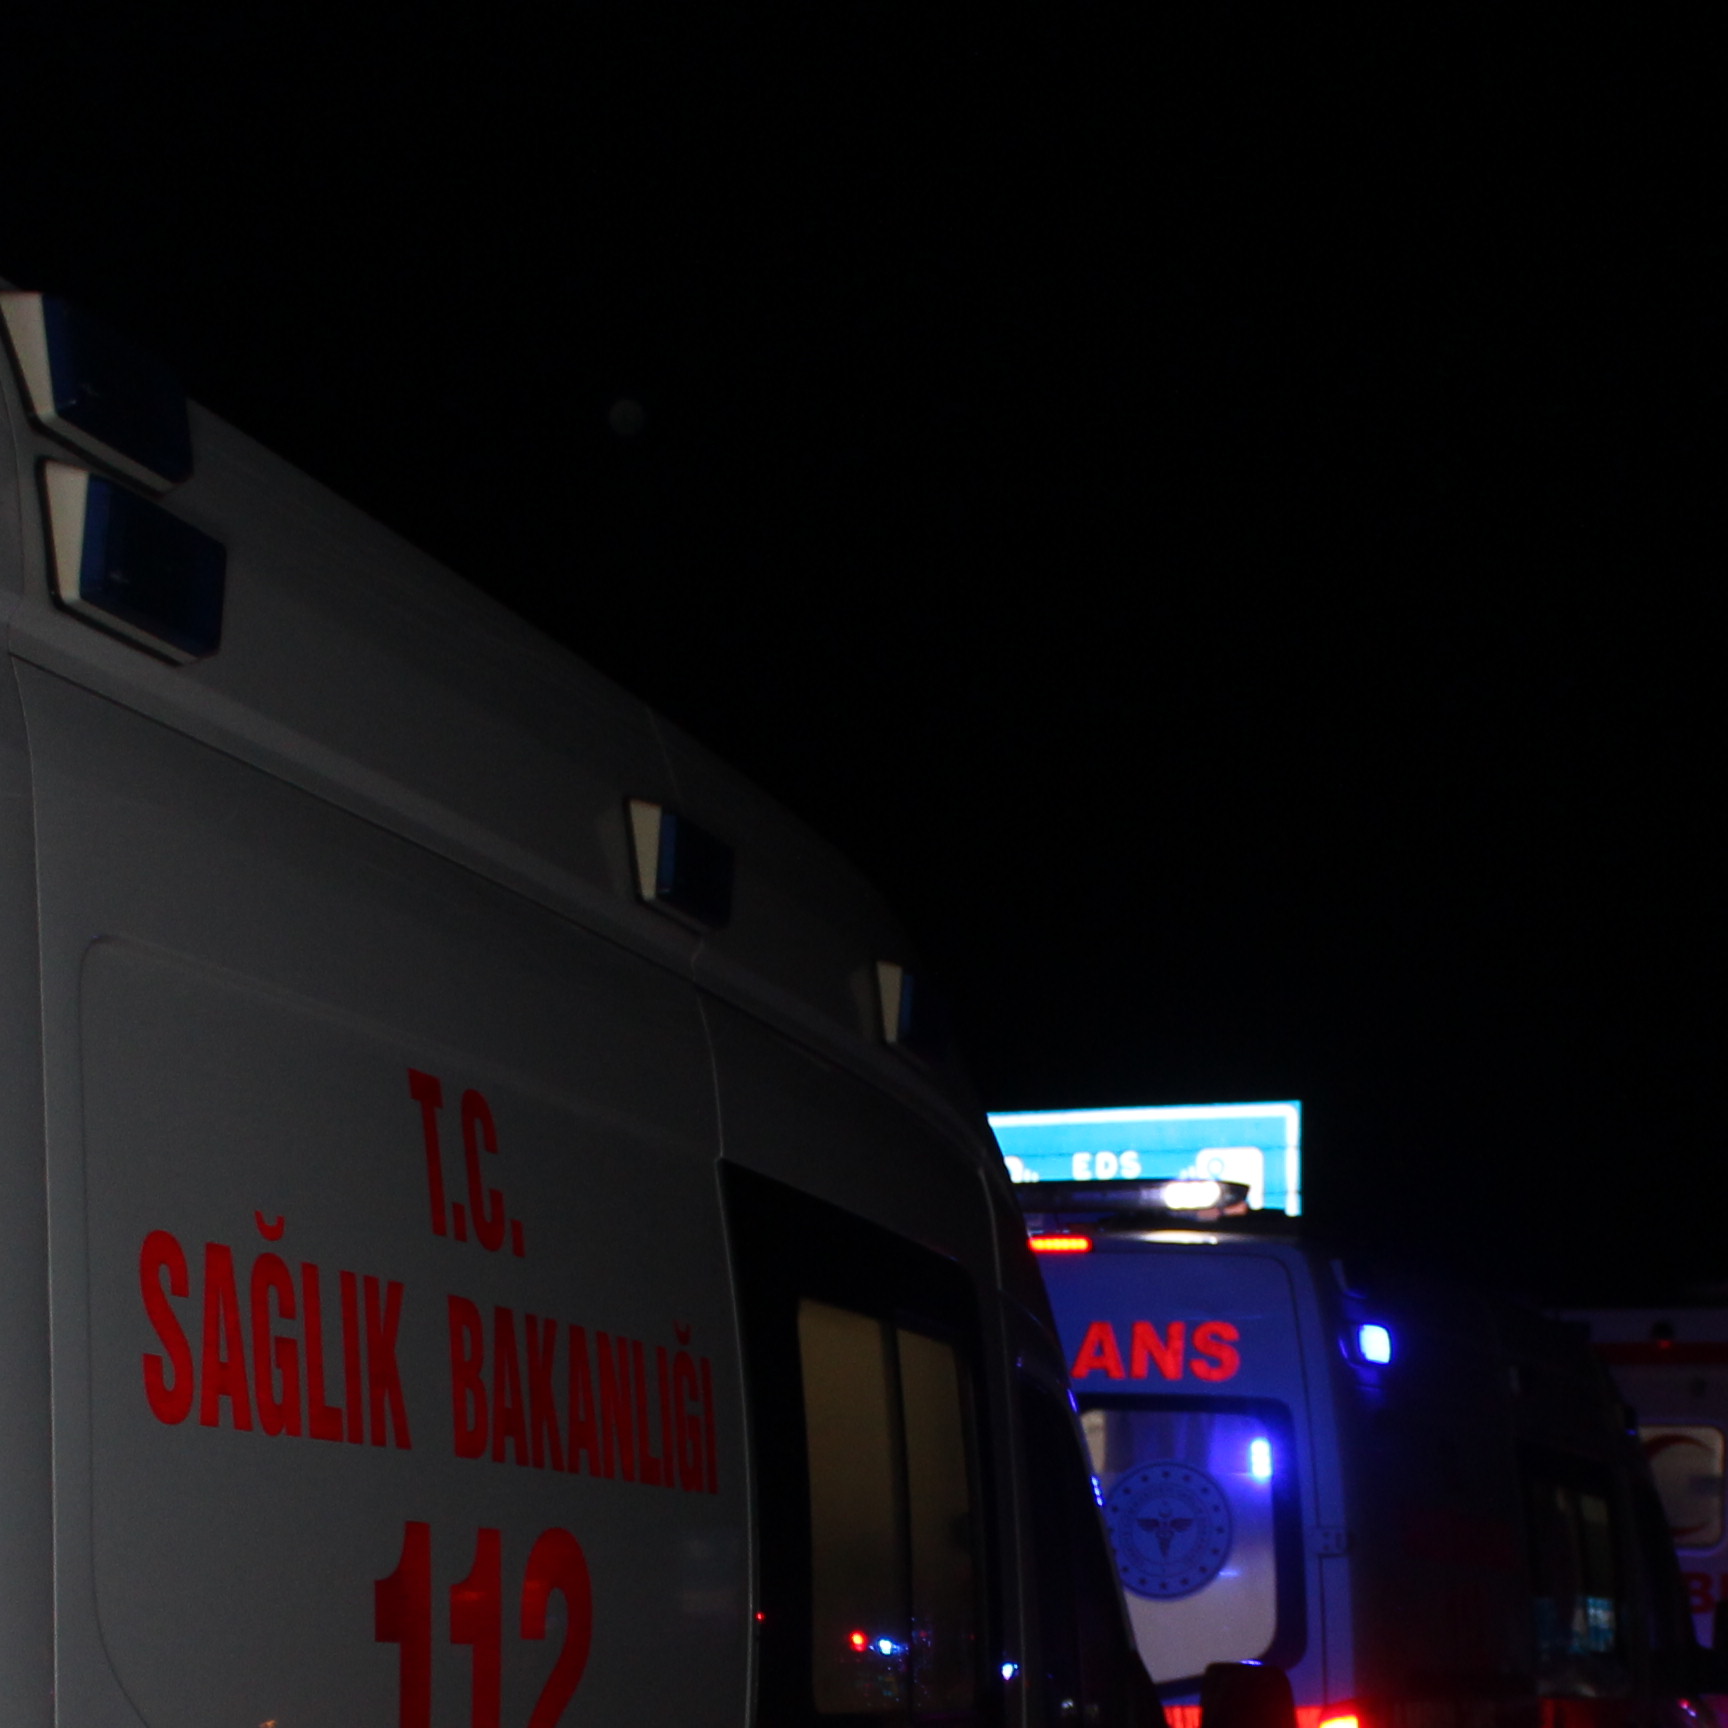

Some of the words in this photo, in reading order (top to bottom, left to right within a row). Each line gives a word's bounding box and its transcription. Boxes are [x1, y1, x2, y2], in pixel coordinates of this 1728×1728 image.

[408, 1068, 525, 1257] T.C.
[1072, 1150, 1141, 1181] EDS
[139, 1211, 412, 1450] SAĞLIK
[447, 1295, 718, 1495] BAKANLIĞI
[1071, 1320, 1241, 1383] ANS
